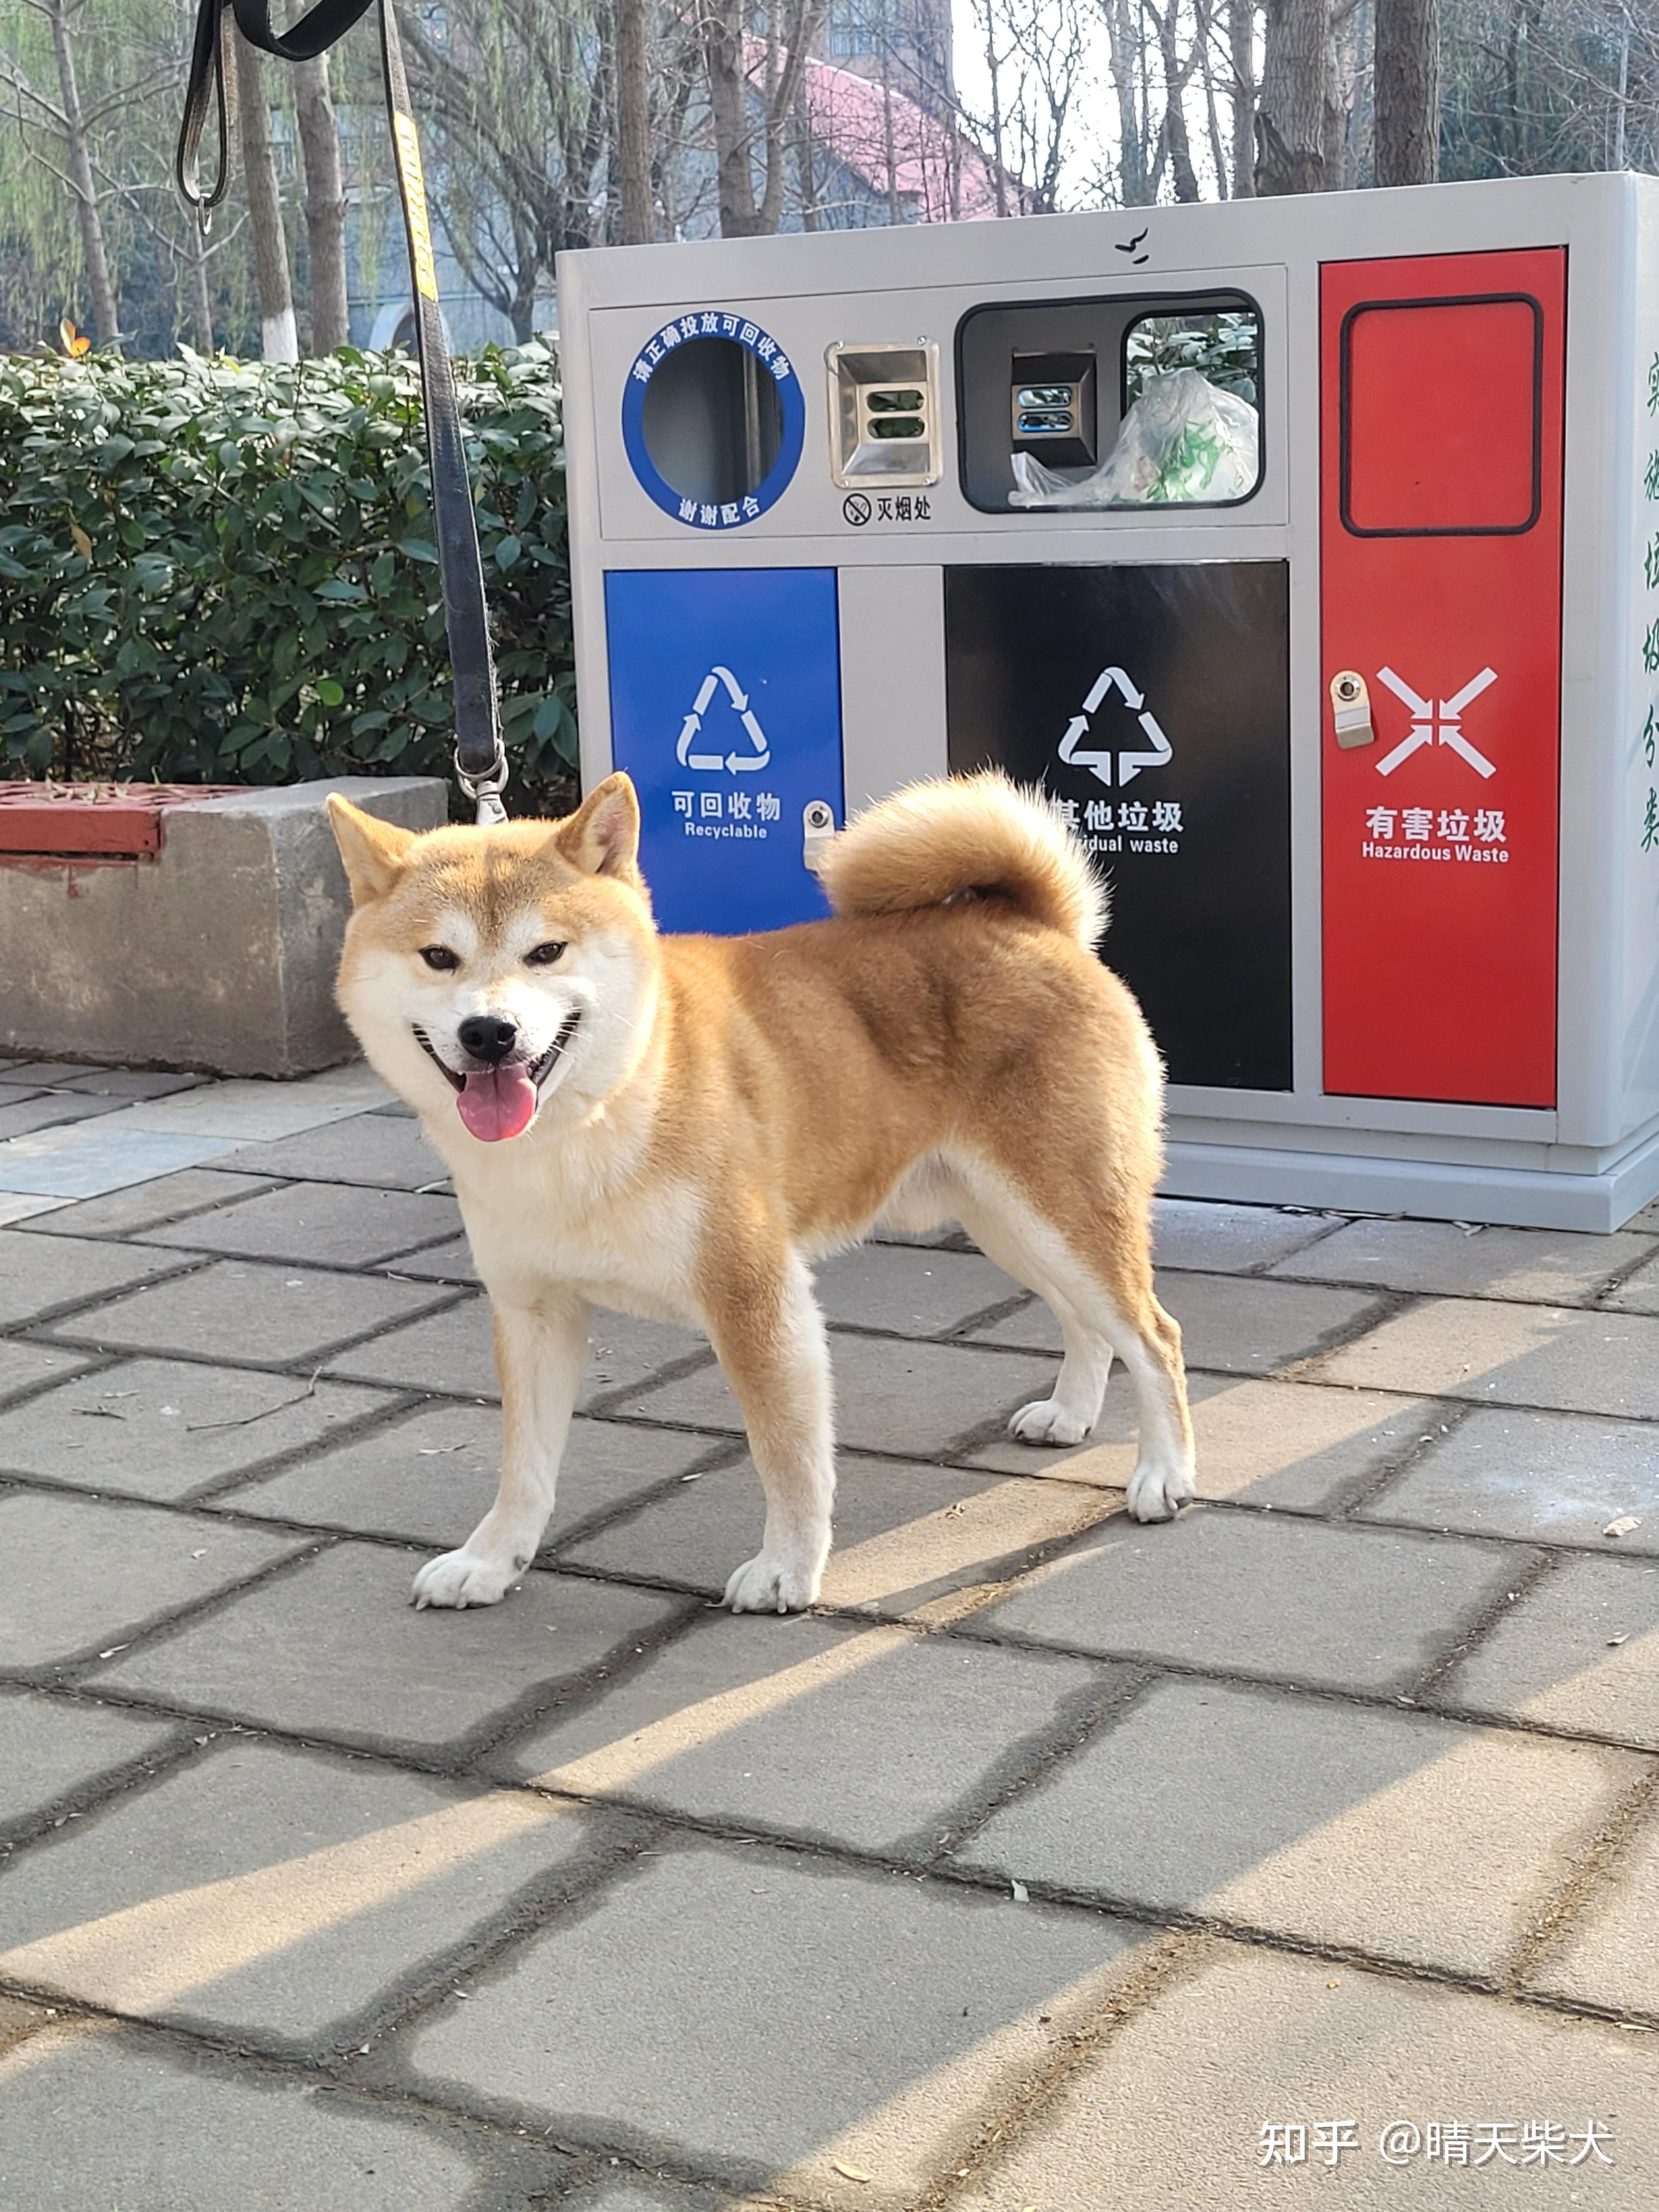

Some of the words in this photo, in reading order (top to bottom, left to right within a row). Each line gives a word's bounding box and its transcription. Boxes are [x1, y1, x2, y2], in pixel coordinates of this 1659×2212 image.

[633, 312, 790, 383] 请正确投放可回收物
[678, 495, 760, 526] 谢谢配合
[877, 495, 932, 522] 灭烟处
[671, 790, 781, 821] 可回收物
[685, 822, 768, 839] Recyclable
[1365, 805, 1507, 843] 有害垃圾
[1077, 834, 1123, 852] idual
[1130, 837, 1179, 854] waste
[1362, 842, 1452, 860] Hazardous
[1454, 845, 1509, 863] Waste
